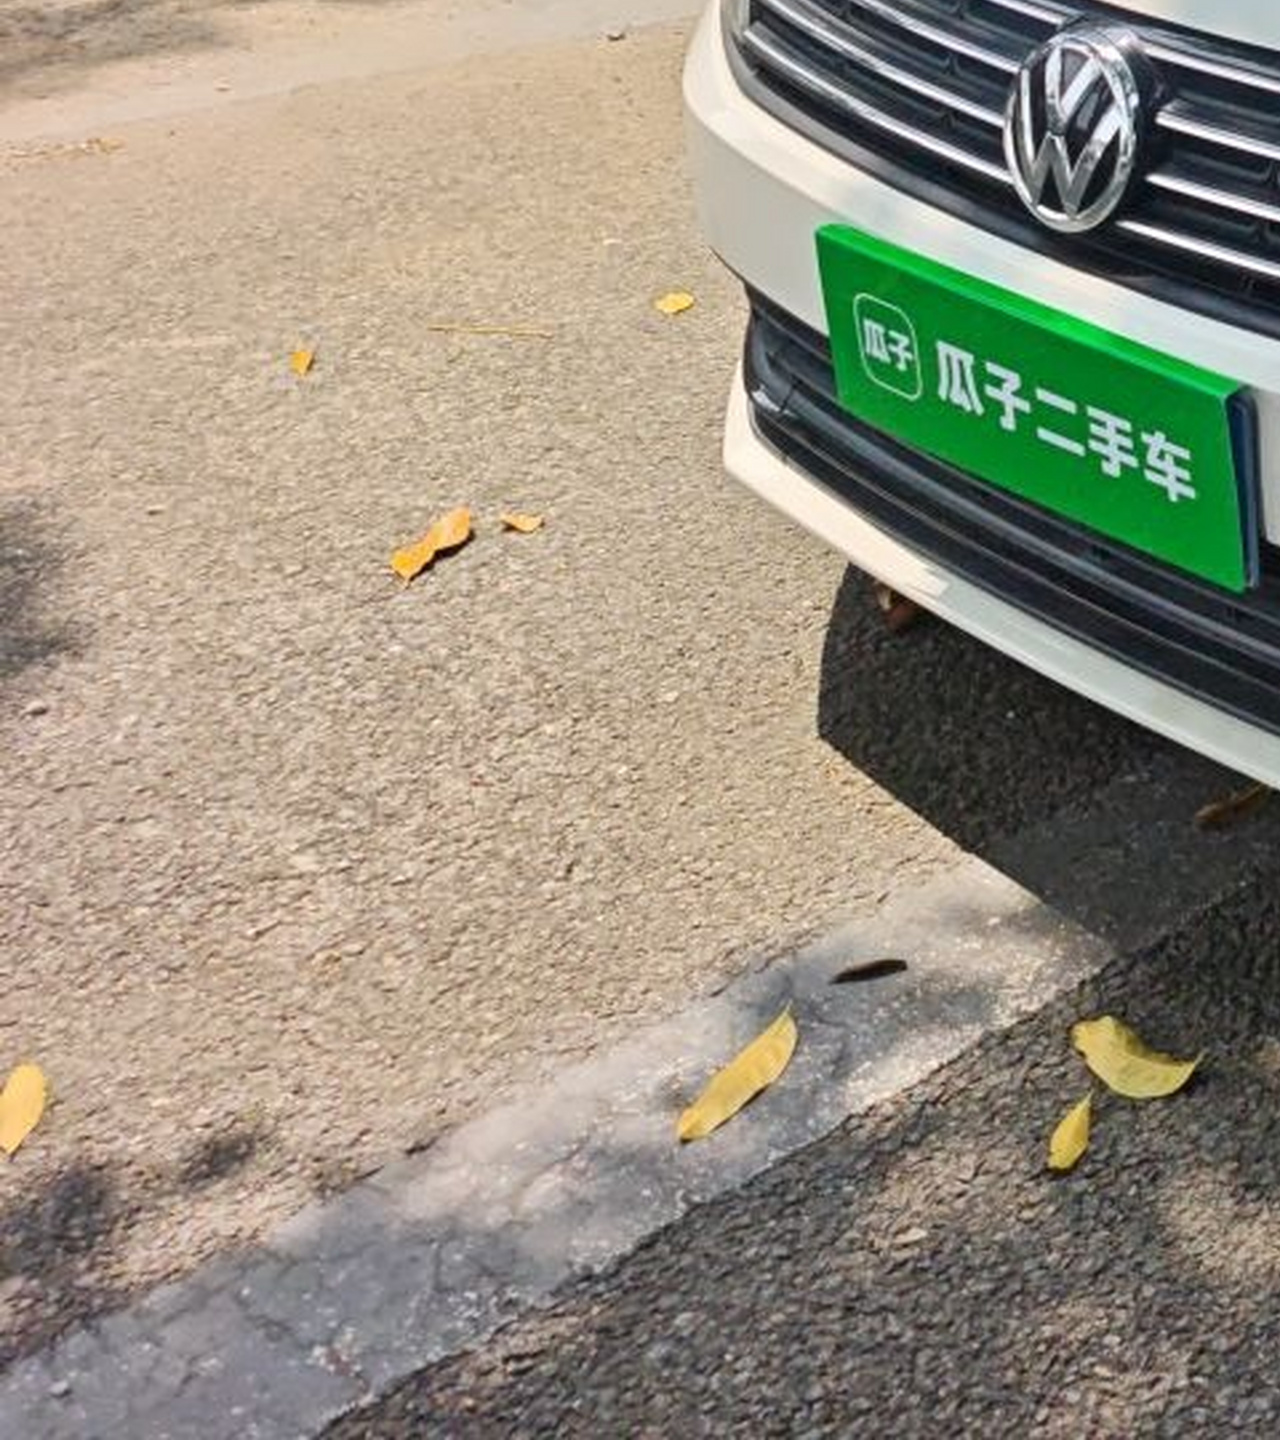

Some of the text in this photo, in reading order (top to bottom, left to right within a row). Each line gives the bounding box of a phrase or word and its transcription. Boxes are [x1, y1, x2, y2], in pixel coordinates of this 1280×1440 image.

[1012, 38, 1130, 222] VW
[863, 319, 914, 372] 瓜子
[935, 340, 1197, 502] 瓜子二手车
